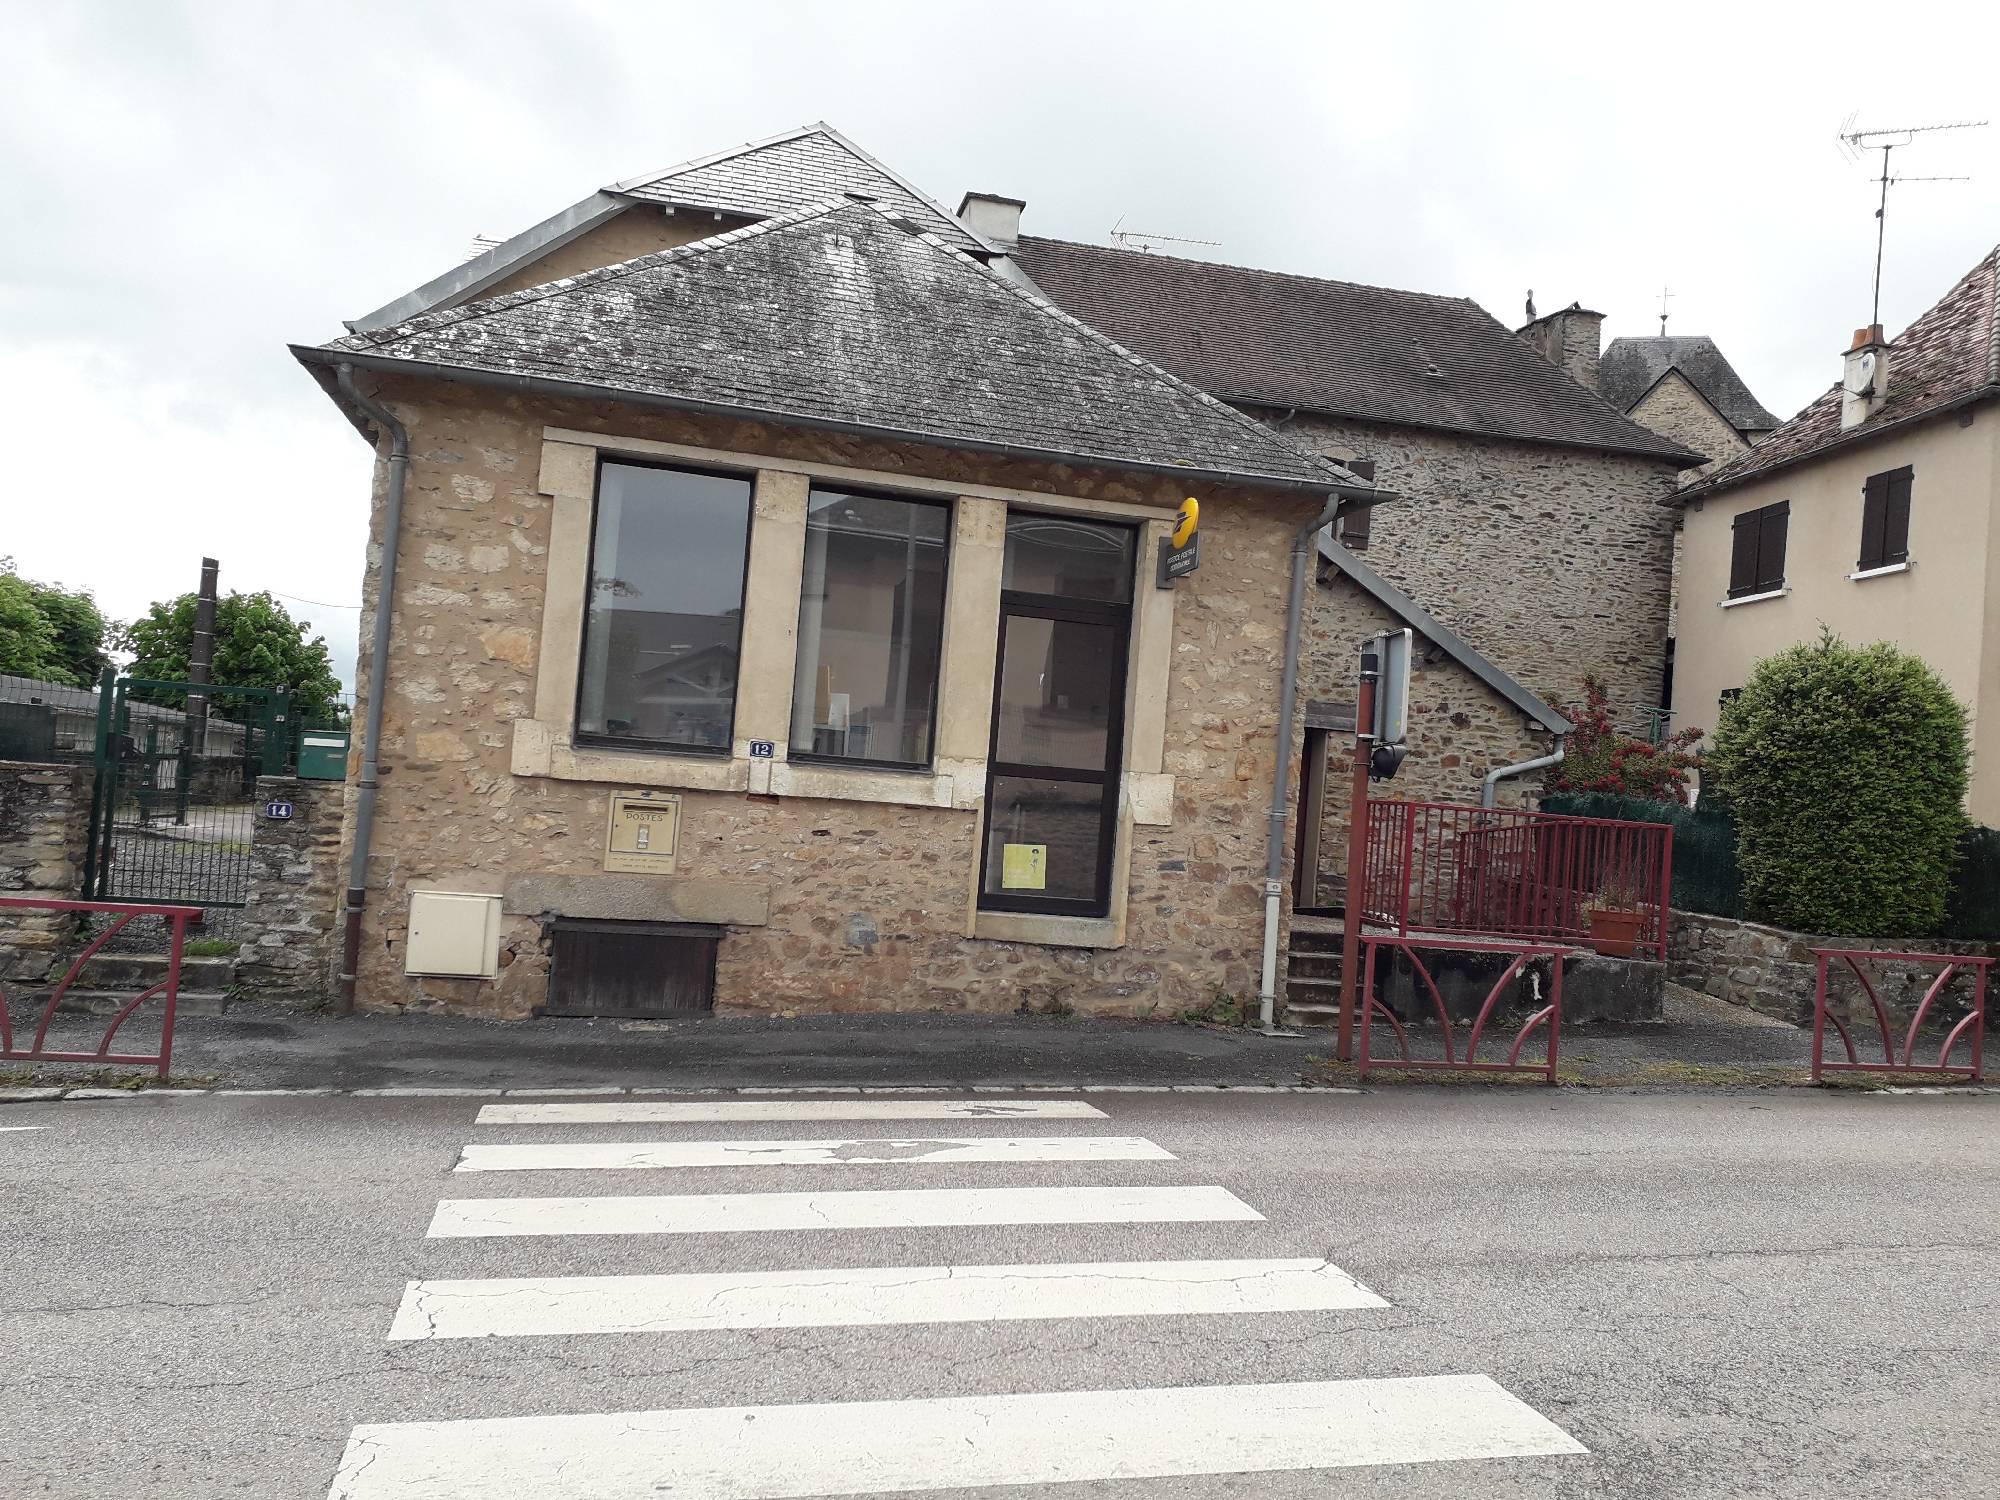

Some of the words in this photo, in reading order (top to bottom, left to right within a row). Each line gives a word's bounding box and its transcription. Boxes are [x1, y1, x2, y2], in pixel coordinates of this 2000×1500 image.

[755, 745, 769, 755] 12
[272, 805, 287, 816] 14
[626, 812, 663, 822] POSTES
